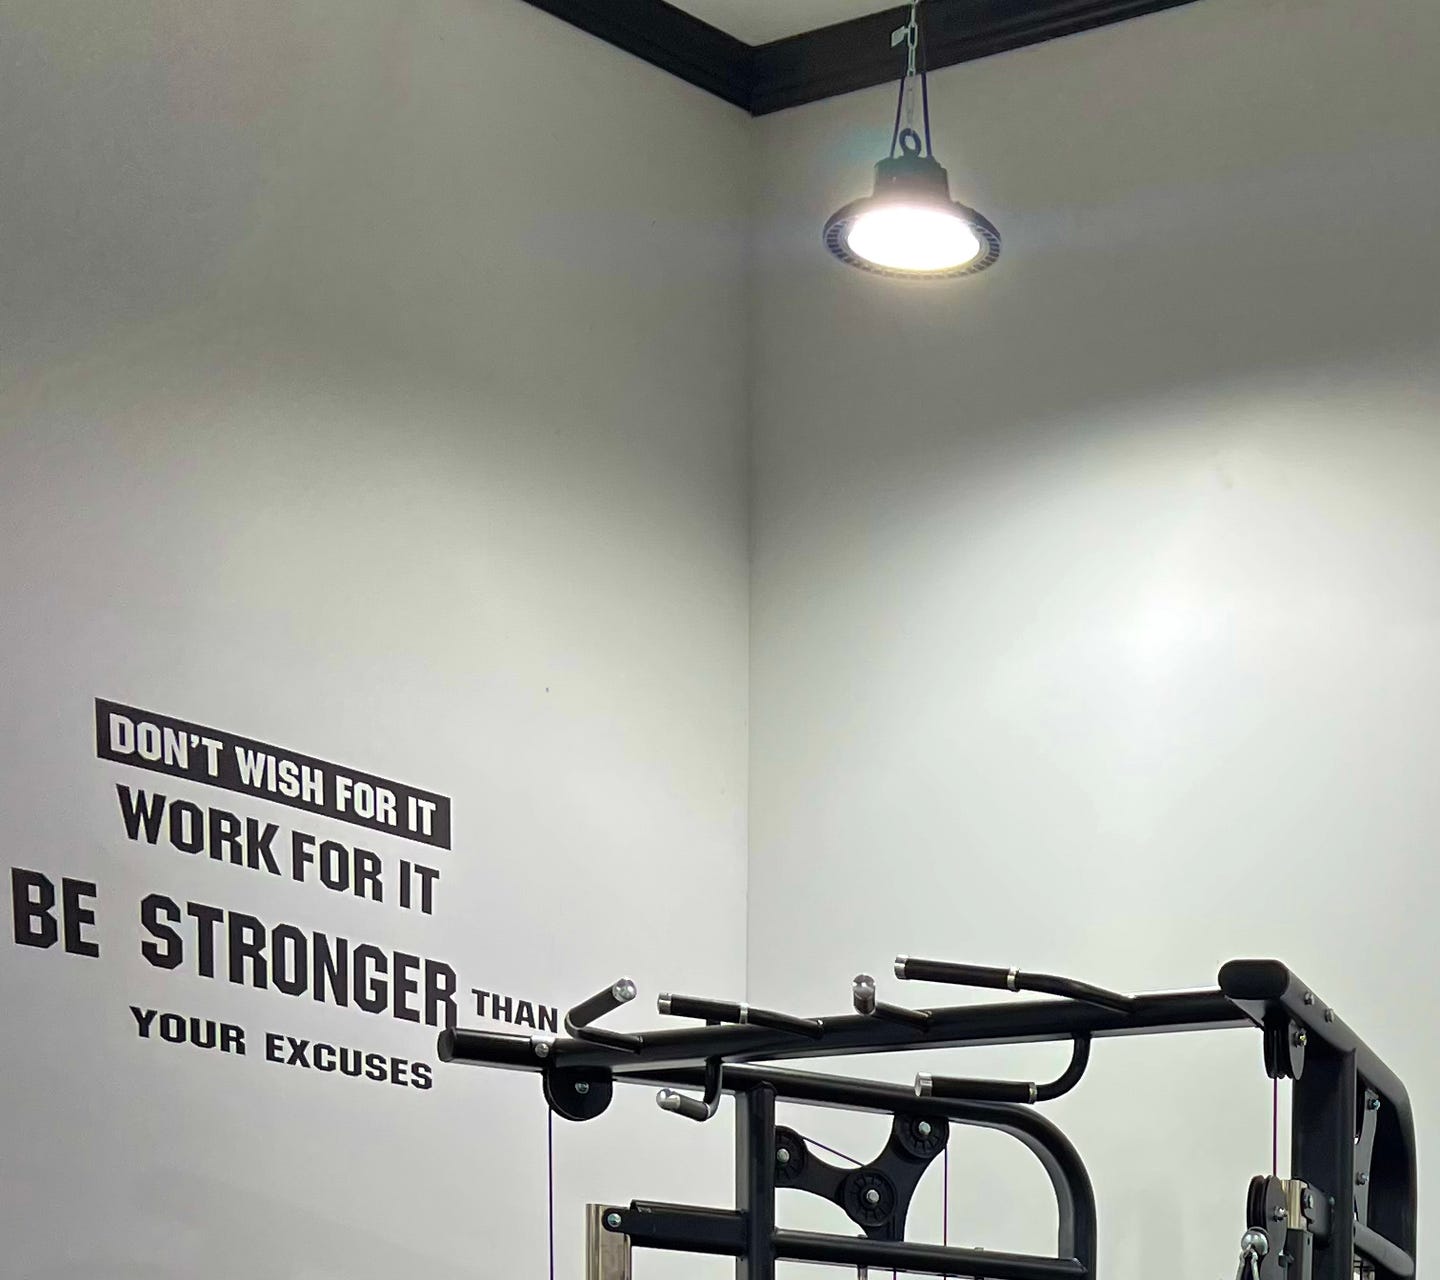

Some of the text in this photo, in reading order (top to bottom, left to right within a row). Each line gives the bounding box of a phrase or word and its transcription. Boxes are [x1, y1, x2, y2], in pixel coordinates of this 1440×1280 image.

[109, 713, 437, 836] DON'T WISH FOR IT
[116, 783, 440, 915] WORK FOR IT
[11, 866, 559, 1034] BE STRONGER THAN
[128, 1005, 433, 1090] YOUR EXCUSES
